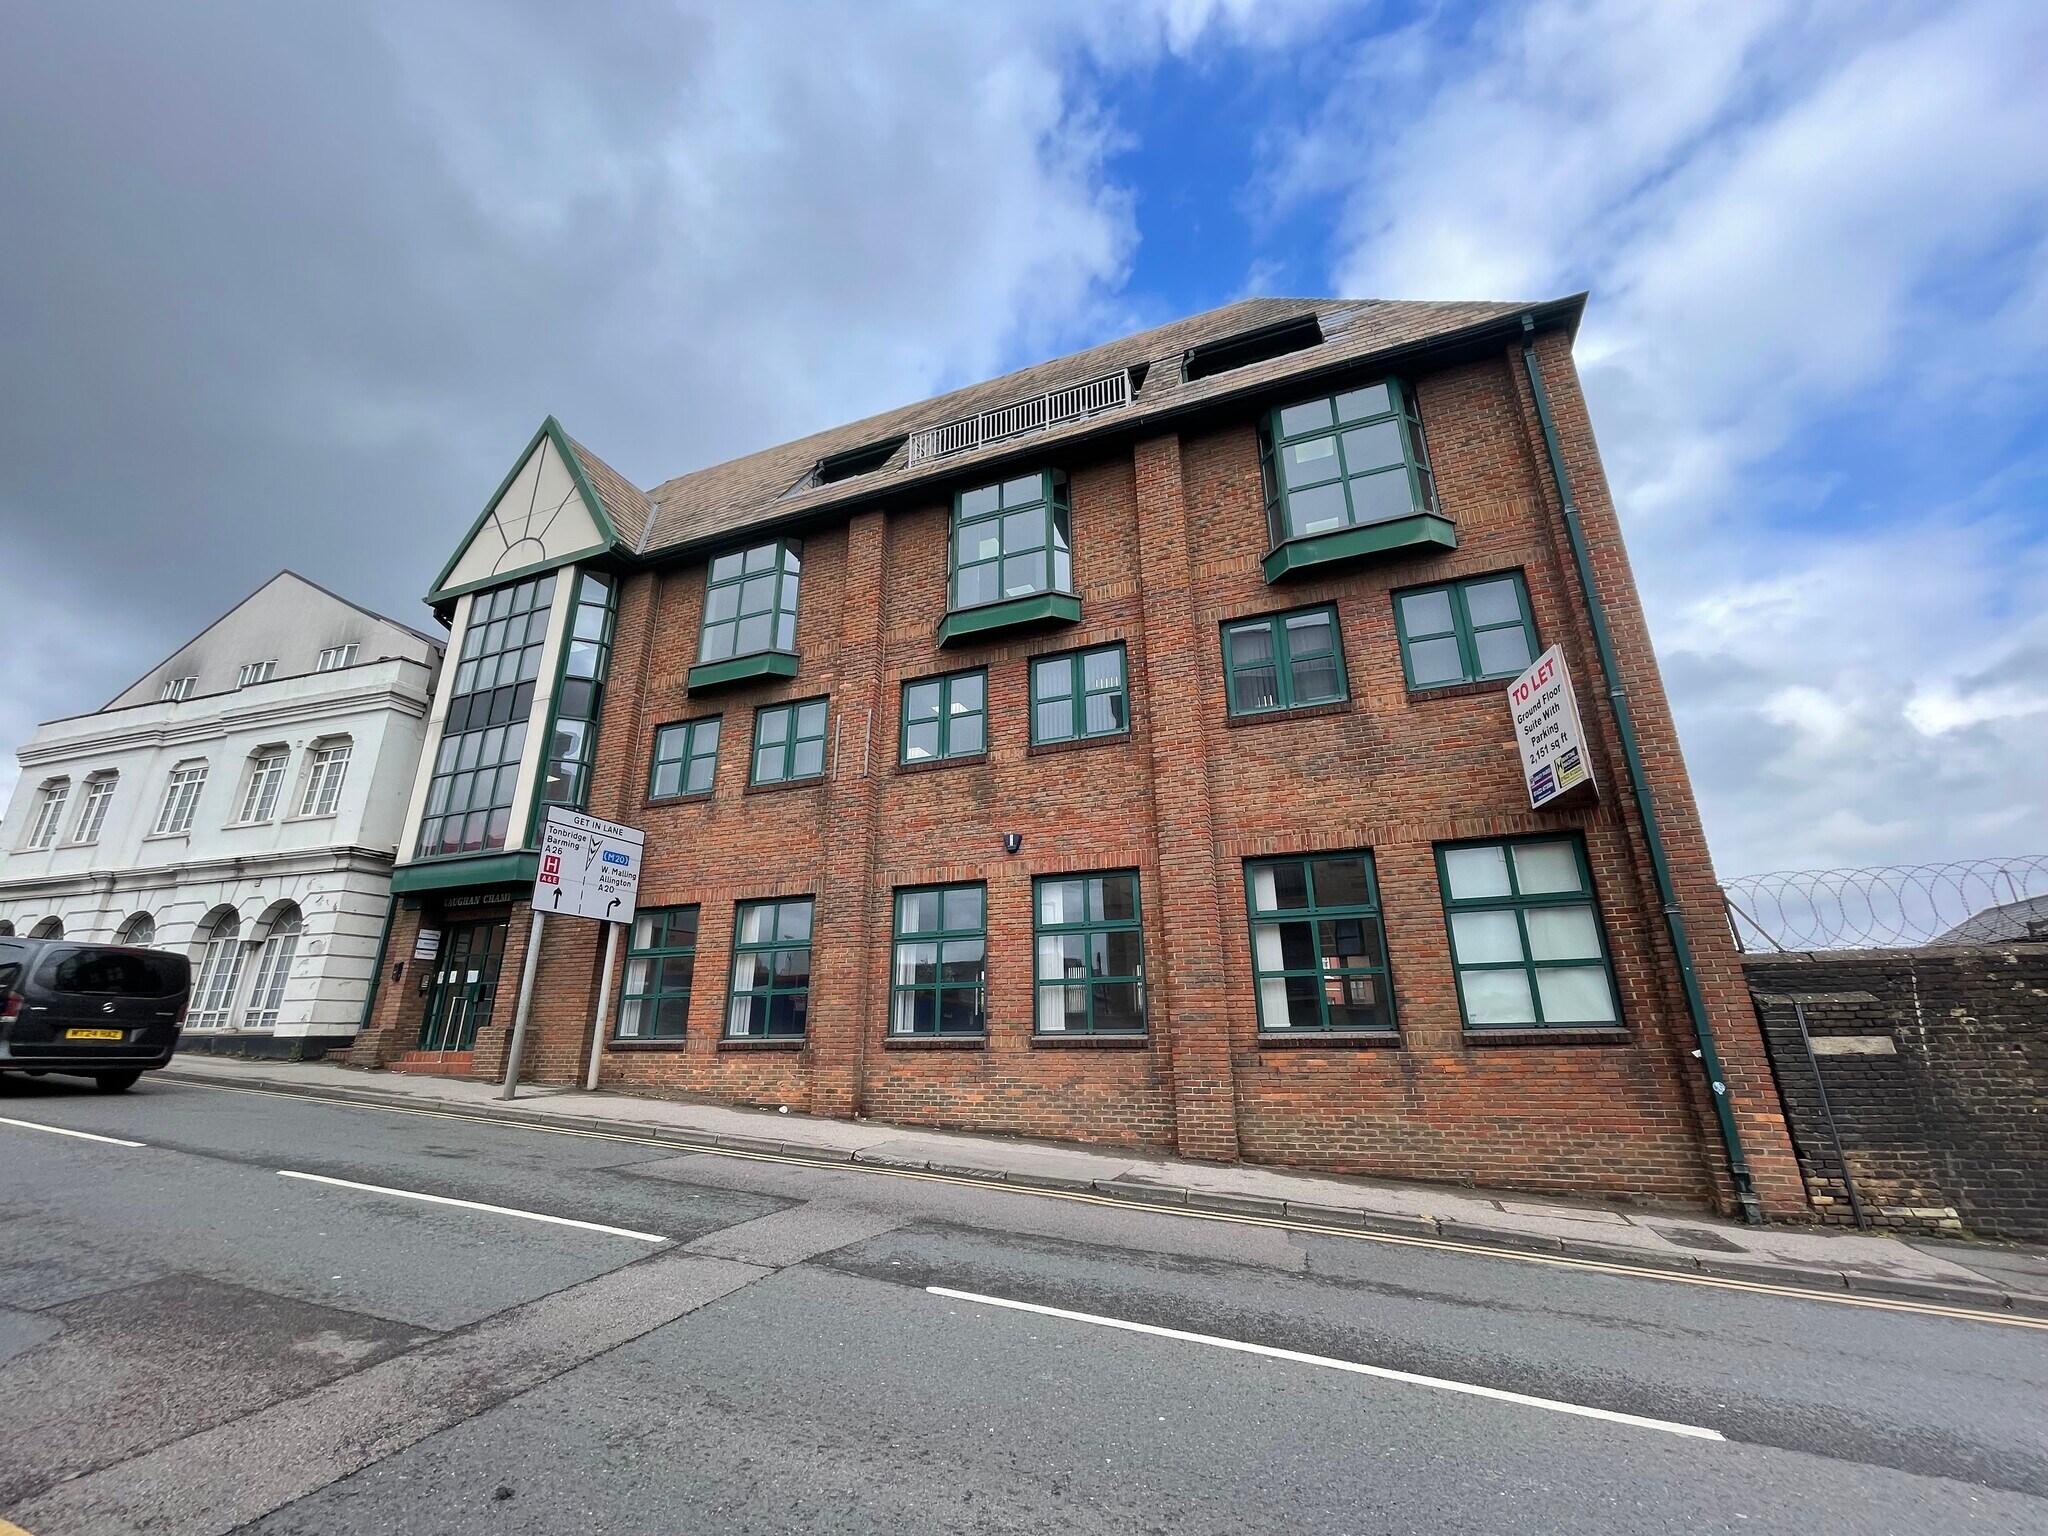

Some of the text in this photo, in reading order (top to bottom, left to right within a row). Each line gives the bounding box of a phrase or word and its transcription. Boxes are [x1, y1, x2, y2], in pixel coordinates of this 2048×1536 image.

[1512, 658, 1554, 706] TO LET
[1517, 684, 1561, 724] Ground Floor
[1524, 702, 1561, 736] Suite With
[1531, 721, 1560, 747] Parking
[1529, 744, 1549, 765] 2,151
[1550, 737, 1560, 751] sq
[1561, 731, 1568, 743] ft
[549, 826, 587, 842] Tonbridge
[574, 816, 624, 836] GET IN LANE
[545, 845, 563, 855] A26
[548, 835, 580, 850] Barming
[546, 856, 558, 873] H
[603, 852, 628, 863] (M20)
[541, 875, 558, 884] A&E
[599, 875, 632, 887] Allington
[612, 868, 637, 881] Malling
[598, 884, 615, 893] A20
